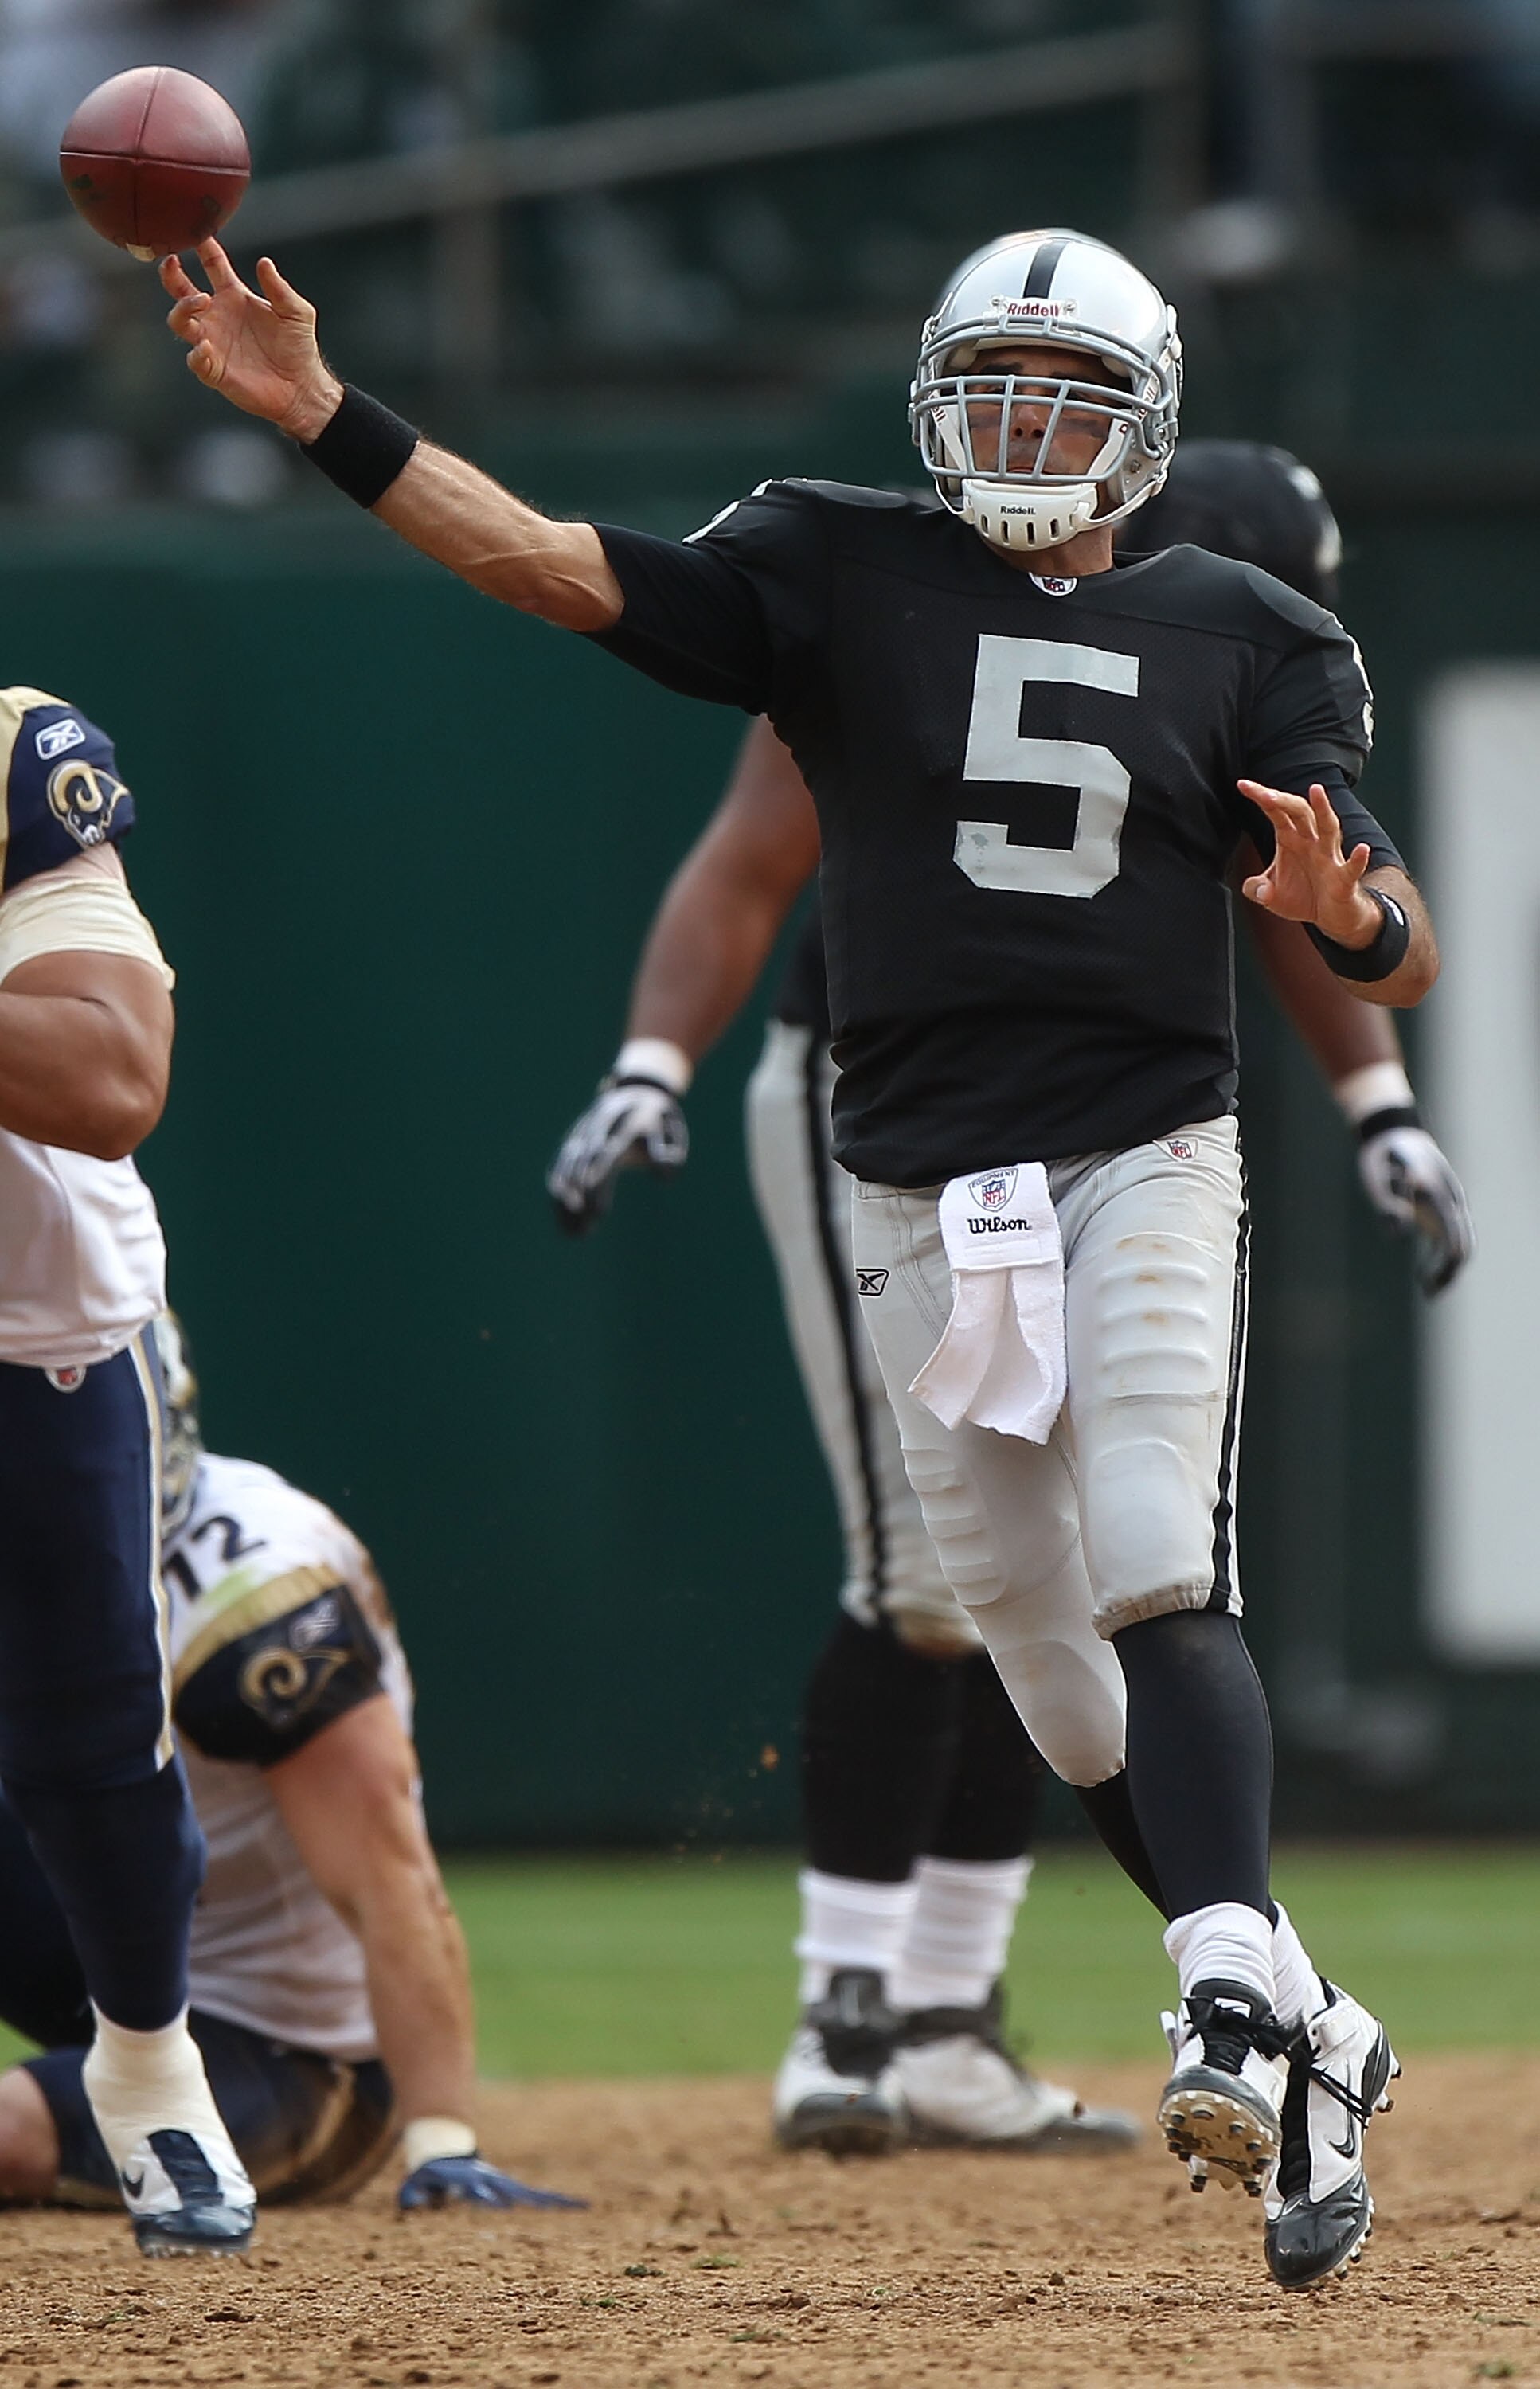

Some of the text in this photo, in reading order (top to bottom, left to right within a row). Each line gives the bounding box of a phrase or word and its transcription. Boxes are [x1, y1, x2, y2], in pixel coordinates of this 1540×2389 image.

[1006, 303, 1060, 317] Riddell
[1000, 506, 1036, 514] Riddell
[953, 634, 1139, 899] 5
[983, 1189, 1006, 1205] NFL
[967, 1216, 1031, 1234] Wilson
[160, 1515, 267, 1600] 72
